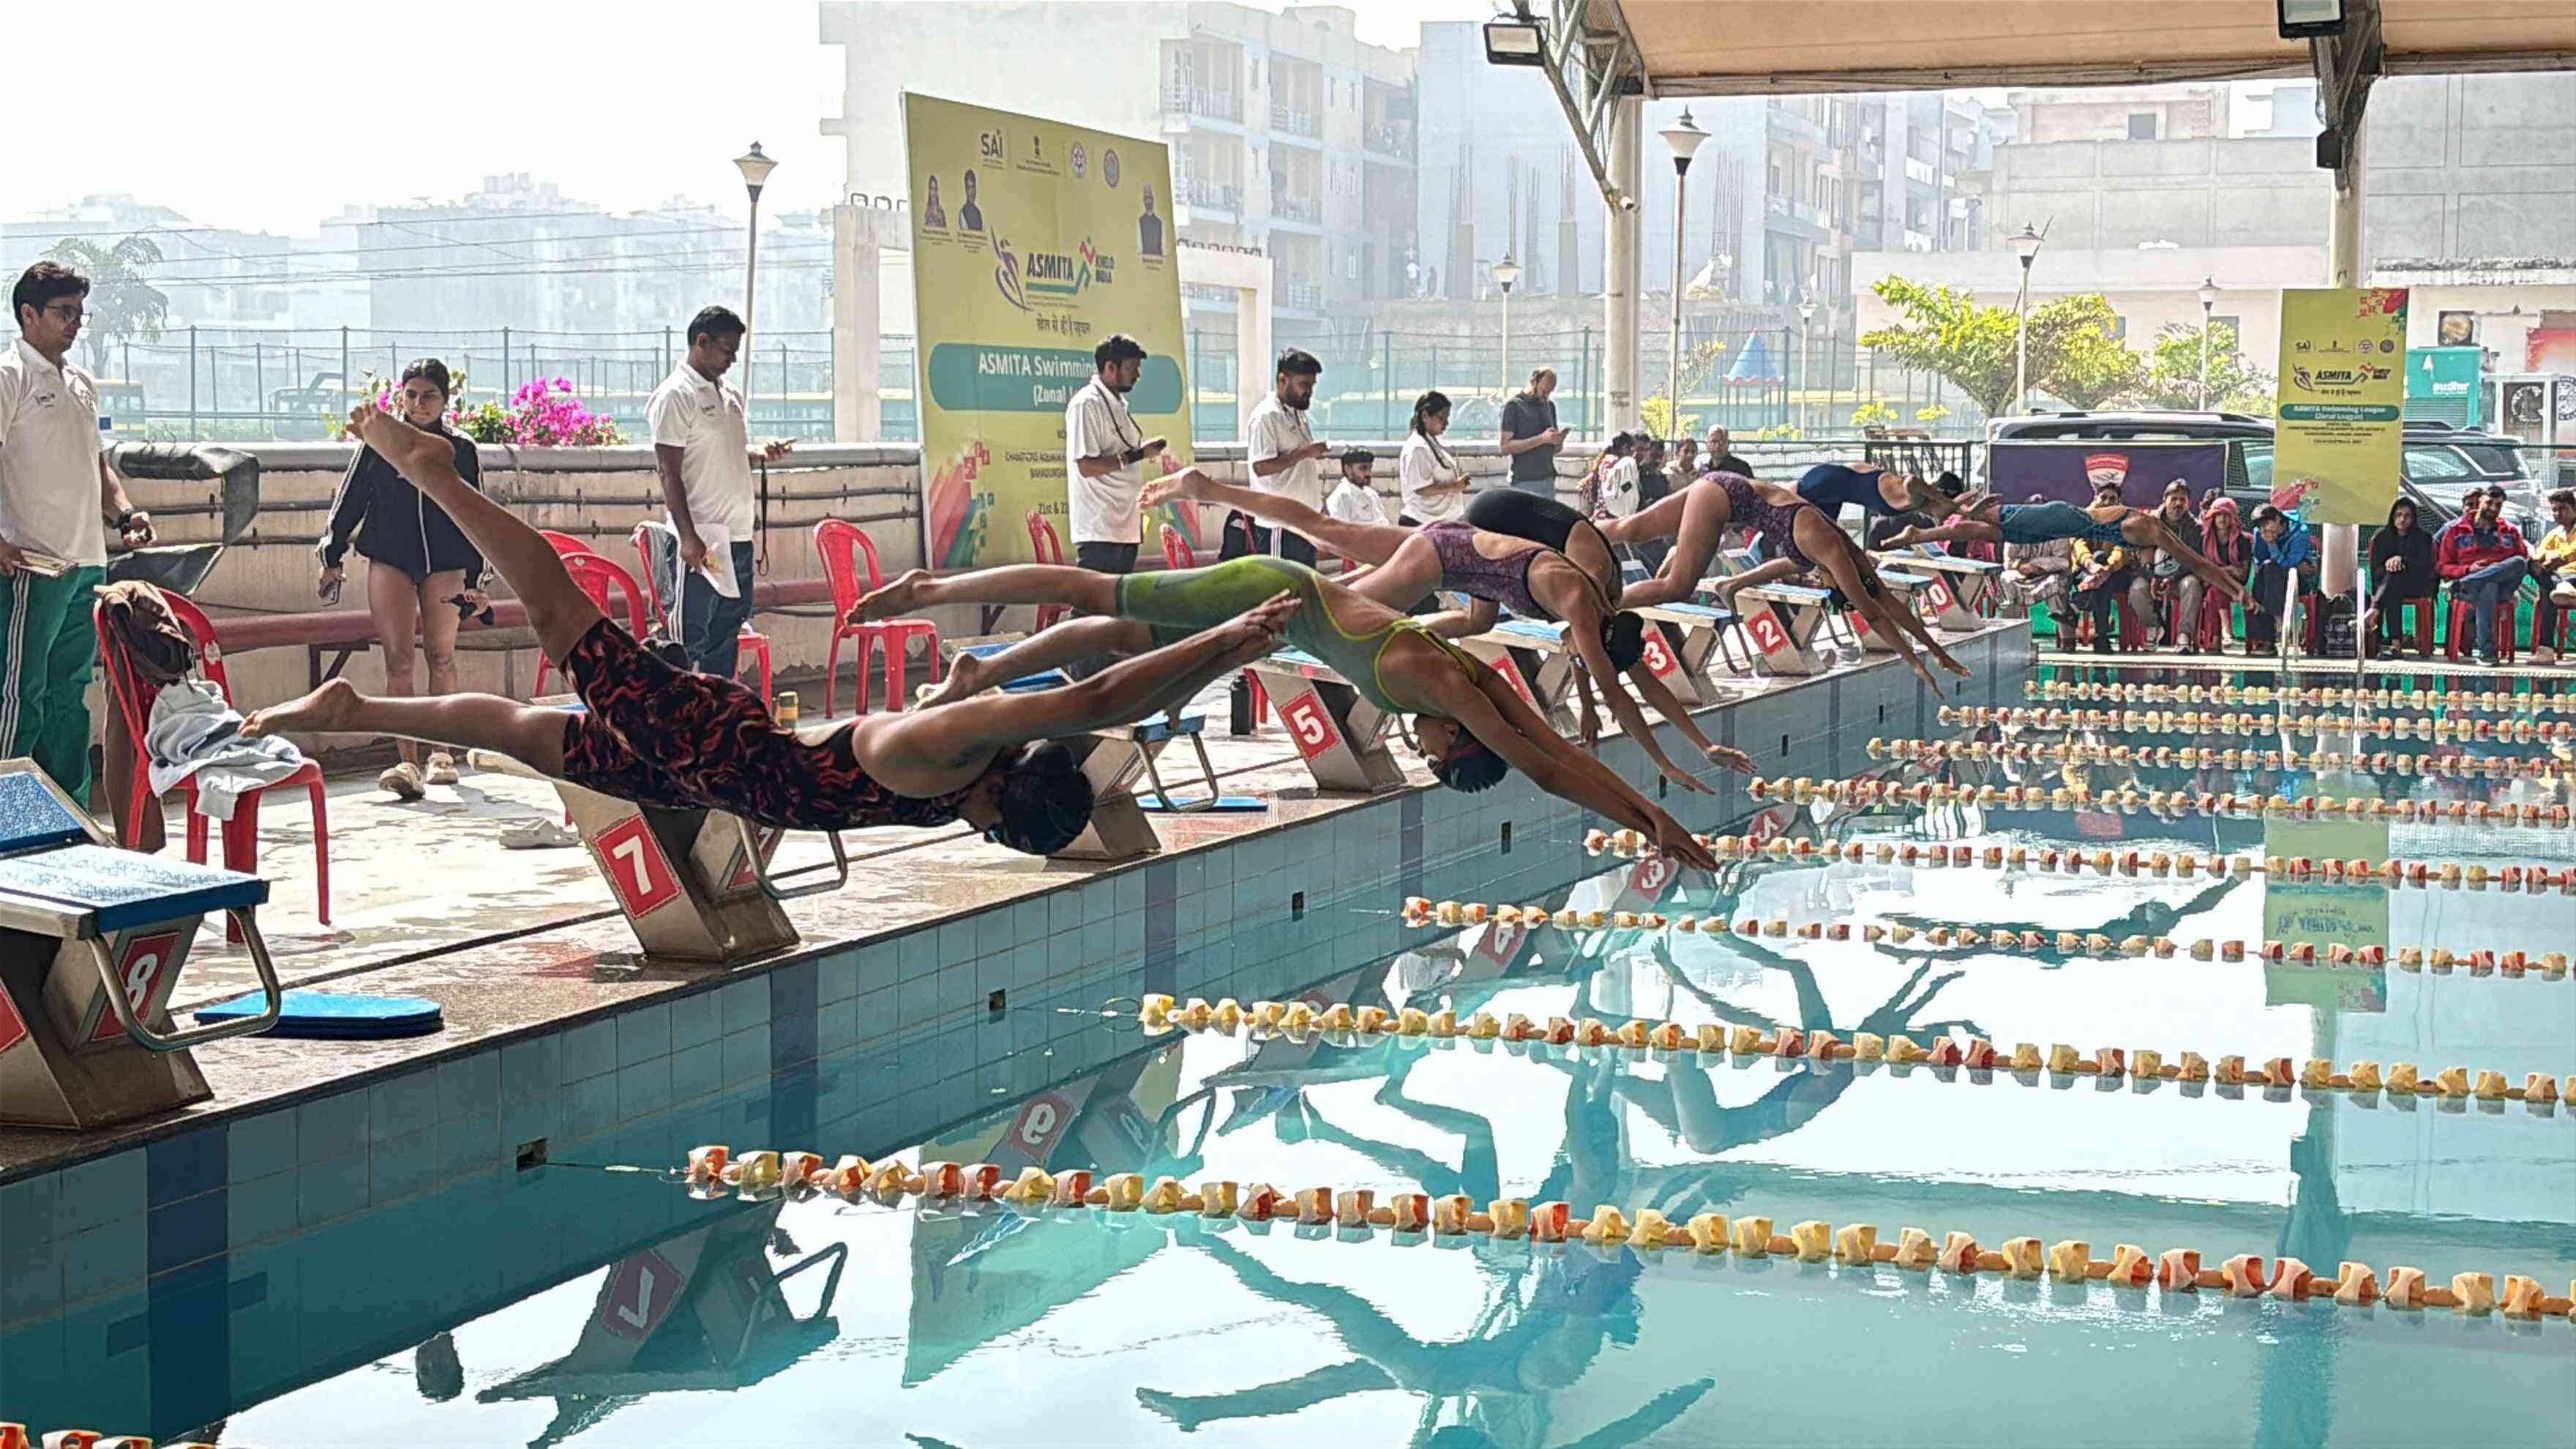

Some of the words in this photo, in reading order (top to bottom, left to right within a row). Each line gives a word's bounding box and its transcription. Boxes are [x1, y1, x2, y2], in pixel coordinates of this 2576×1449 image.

[1027, 252, 1074, 281] ASMITA
[978, 352, 1032, 376] ASMITA
[2315, 371, 2352, 381] ASMITA
[1757, 620, 1781, 647] 2
[1644, 641, 1667, 670] 3
[1291, 705, 1325, 746] 5
[613, 835, 654, 896] 7
[126, 953, 157, 1014] 8
